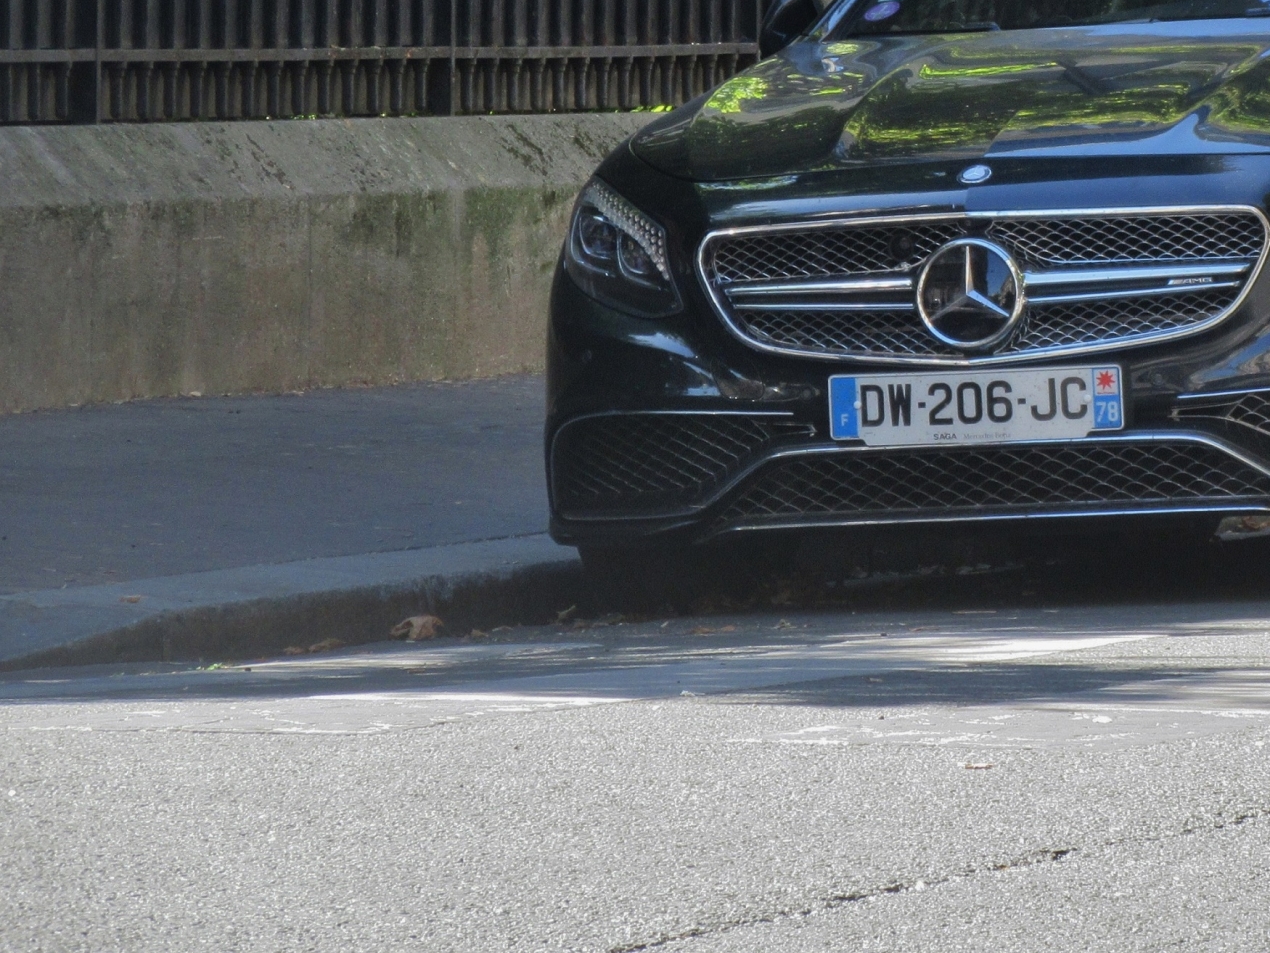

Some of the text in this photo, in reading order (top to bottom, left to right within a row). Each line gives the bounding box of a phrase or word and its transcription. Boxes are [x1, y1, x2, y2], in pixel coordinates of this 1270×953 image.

[860, 376, 1089, 427] DW-206-JC
[1096, 401, 1119, 422] 78
[841, 414, 849, 427] F
[933, 433, 958, 441] SAGA
